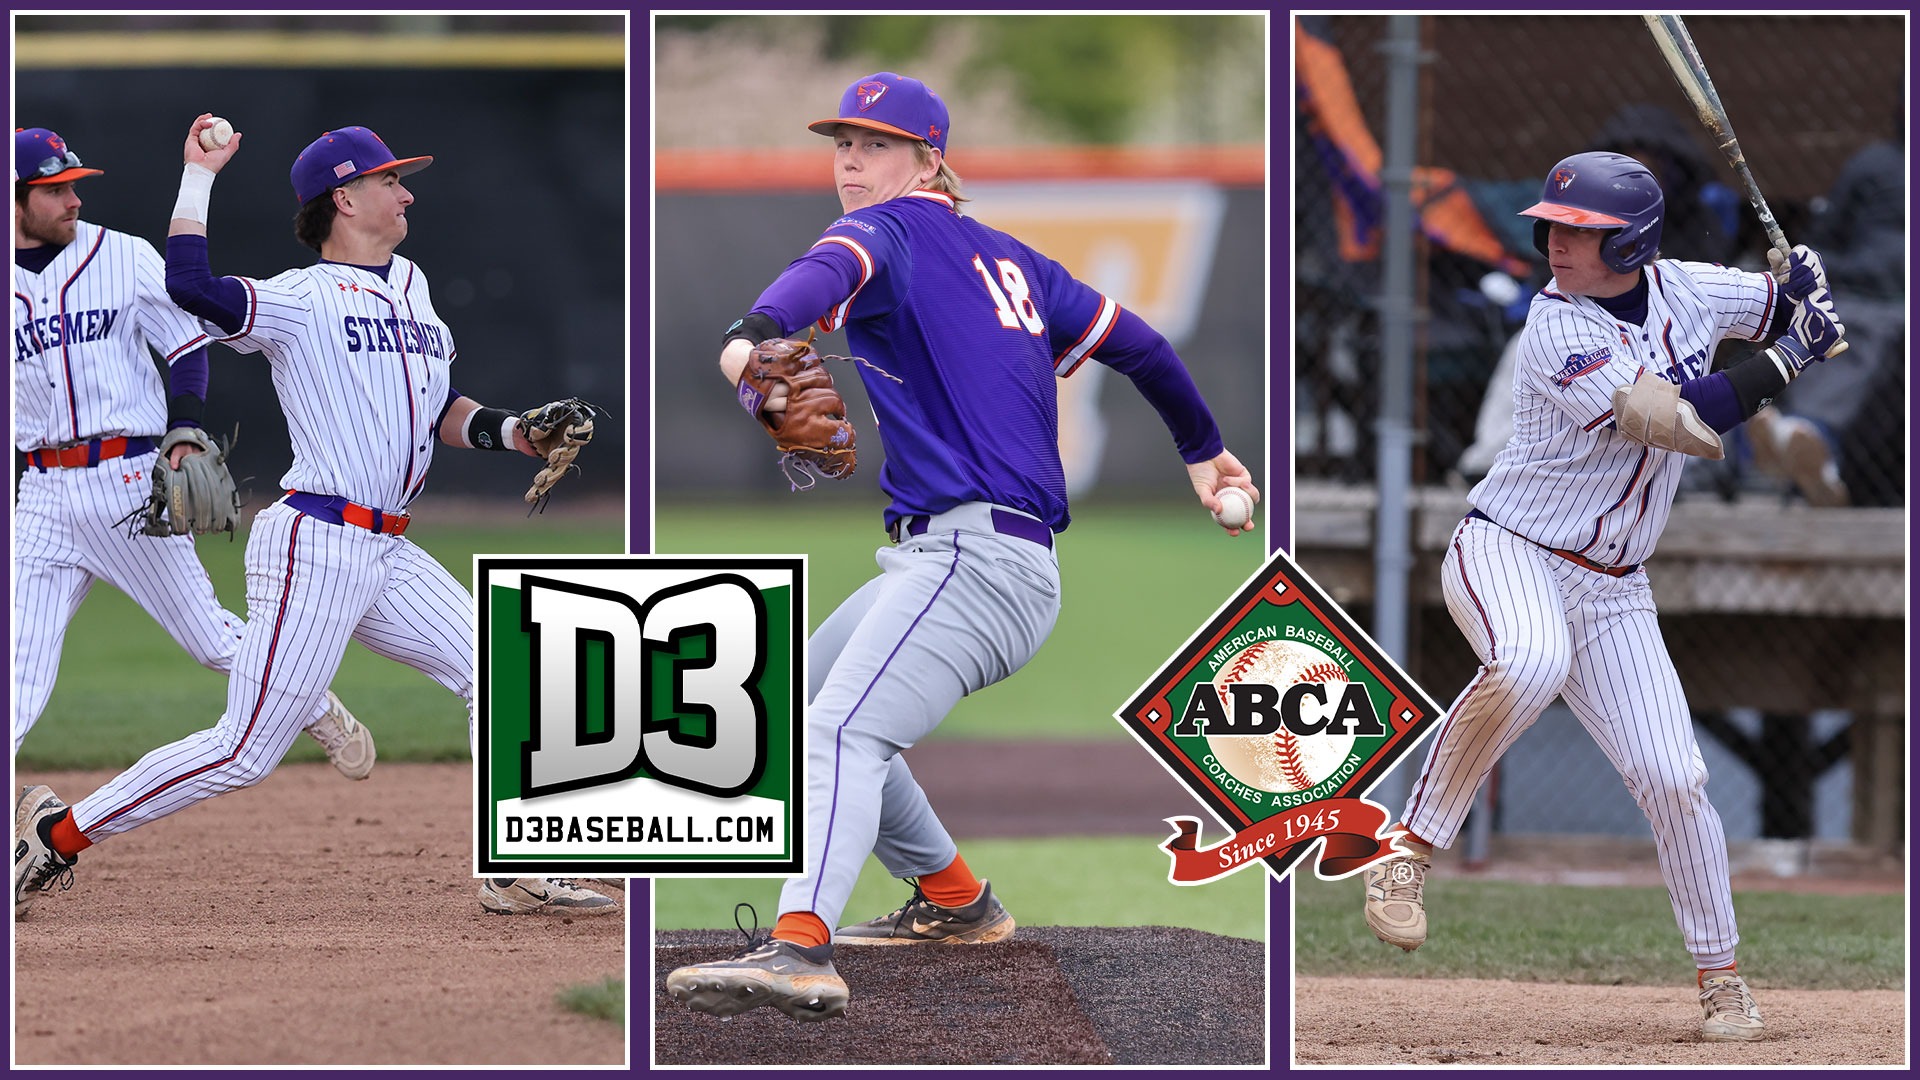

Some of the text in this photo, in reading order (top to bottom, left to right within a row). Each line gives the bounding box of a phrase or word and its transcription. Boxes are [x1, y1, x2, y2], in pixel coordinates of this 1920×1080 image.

[971, 253, 1046, 337] 18
[343, 315, 446, 361] STATESMEN
[1551, 363, 1579, 384] IBERTY
[1579, 348, 1610, 367] LEAGUE
